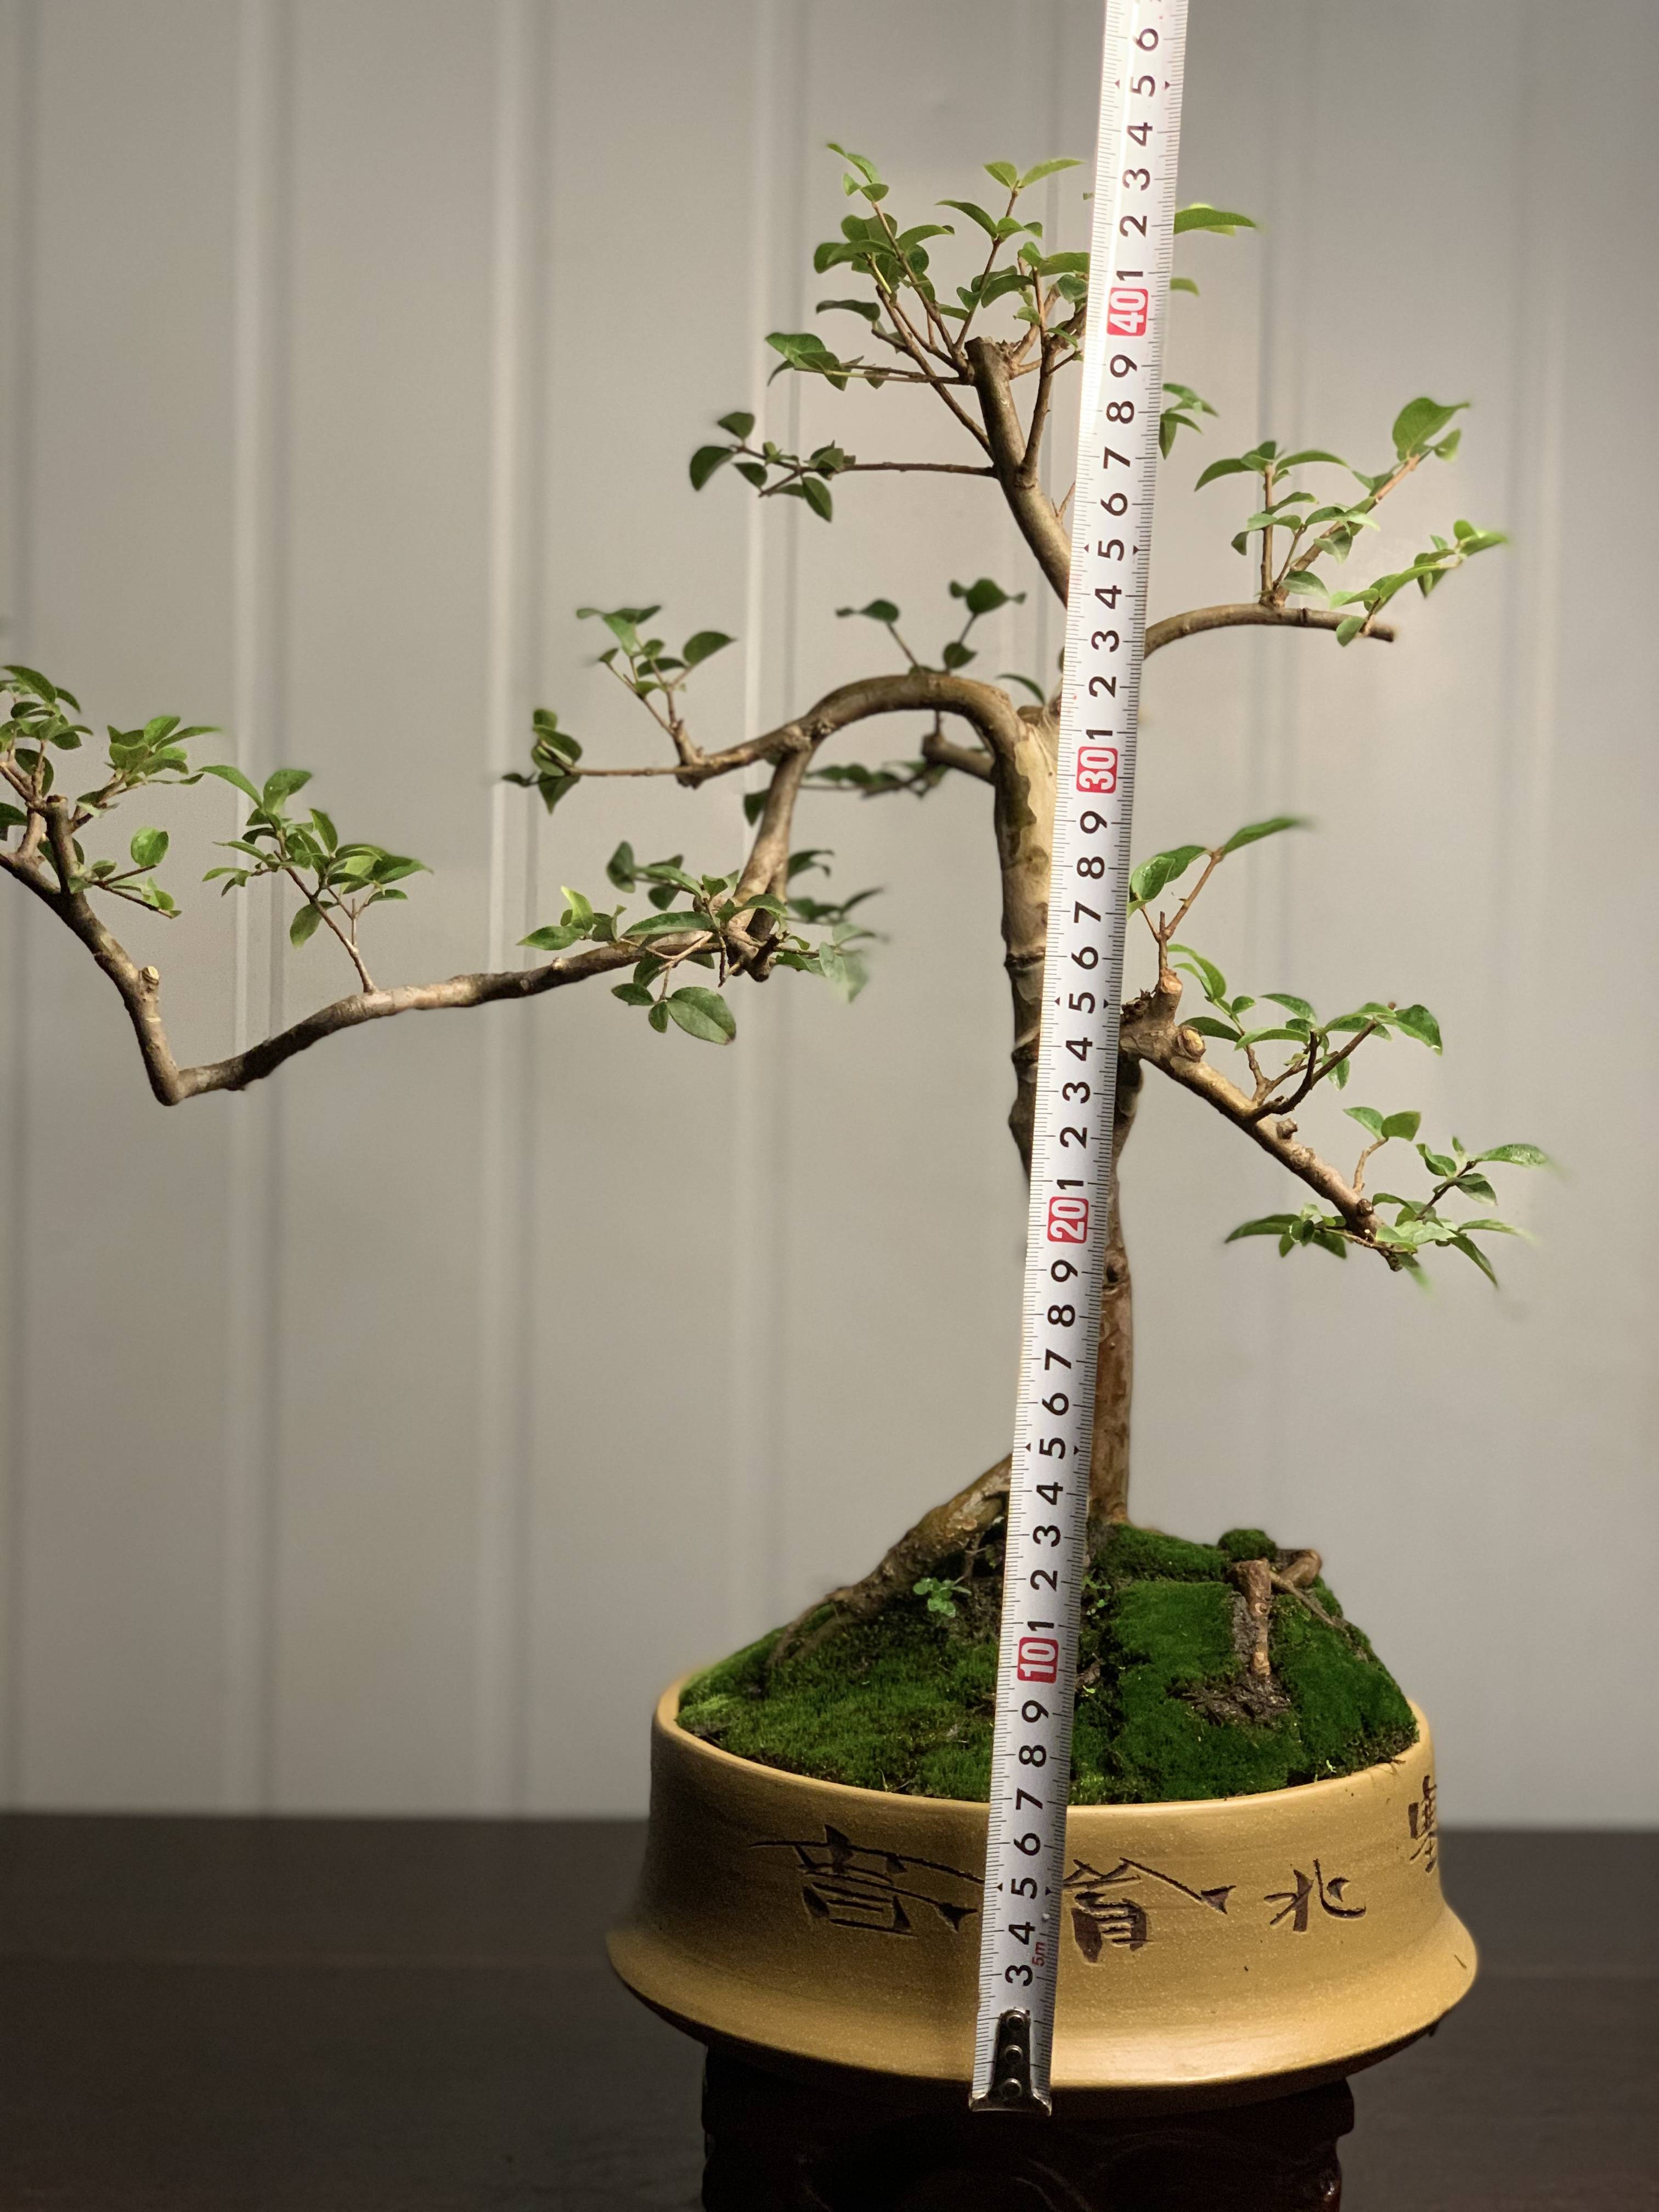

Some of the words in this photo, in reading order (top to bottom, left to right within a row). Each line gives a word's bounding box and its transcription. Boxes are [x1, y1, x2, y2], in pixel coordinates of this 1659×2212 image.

[1133, 28, 1159, 51] 6
[1130, 75, 1155, 97] 5
[1127, 122, 1153, 146] 4
[1122, 168, 1150, 191] 3
[1120, 215, 1147, 238] 2
[1116, 270, 1143, 281] 1
[1109, 290, 1146, 334] 40
[1110, 354, 1137, 377] 9
[1106, 401, 1134, 424] 8
[1103, 447, 1130, 469] 7
[1101, 493, 1127, 516] 6
[1098, 539, 1124, 561] 5
[1095, 585, 1122, 609] 4
[1091, 630, 1119, 652] 3
[1089, 676, 1116, 698] 2
[1086, 729, 1113, 740] 1
[1079, 749, 1115, 790] 30
[1080, 811, 1107, 834] 9
[1077, 856, 1105, 879] 8
[1074, 901, 1101, 923] 7
[1071, 946, 1098, 969] 6
[1069, 992, 1095, 1014] 5
[1065, 1037, 1093, 1061] 4
[1062, 1082, 1090, 1104] 3
[1060, 1127, 1087, 1149] 2
[1057, 1180, 1084, 1190] 1
[1050, 1199, 1086, 1240] 20
[1051, 1260, 1078, 1282] 9
[1047, 1305, 1075, 1327] 8
[1045, 1348, 1071, 1370] 7
[1042, 1393, 1069, 1415] 6
[1039, 1438, 1065, 1459] 5
[1036, 1482, 1063, 1505] 4
[1032, 1525, 1060, 1547] 3
[1030, 1570, 1058, 1592] 2
[1027, 1621, 1054, 1631] 1
[1020, 1643, 1056, 1677] 10
[1022, 1700, 1049, 1723] 9
[1019, 1745, 1047, 1768] 8
[1015, 1788, 1043, 1810] 7
[1013, 1833, 1041, 1856] 6
[1011, 1877, 1037, 1899] 5
[1008, 1921, 1036, 1945] 4
[1031, 1942, 1045, 1966] 5m
[1005, 1965, 1033, 1987] 3
